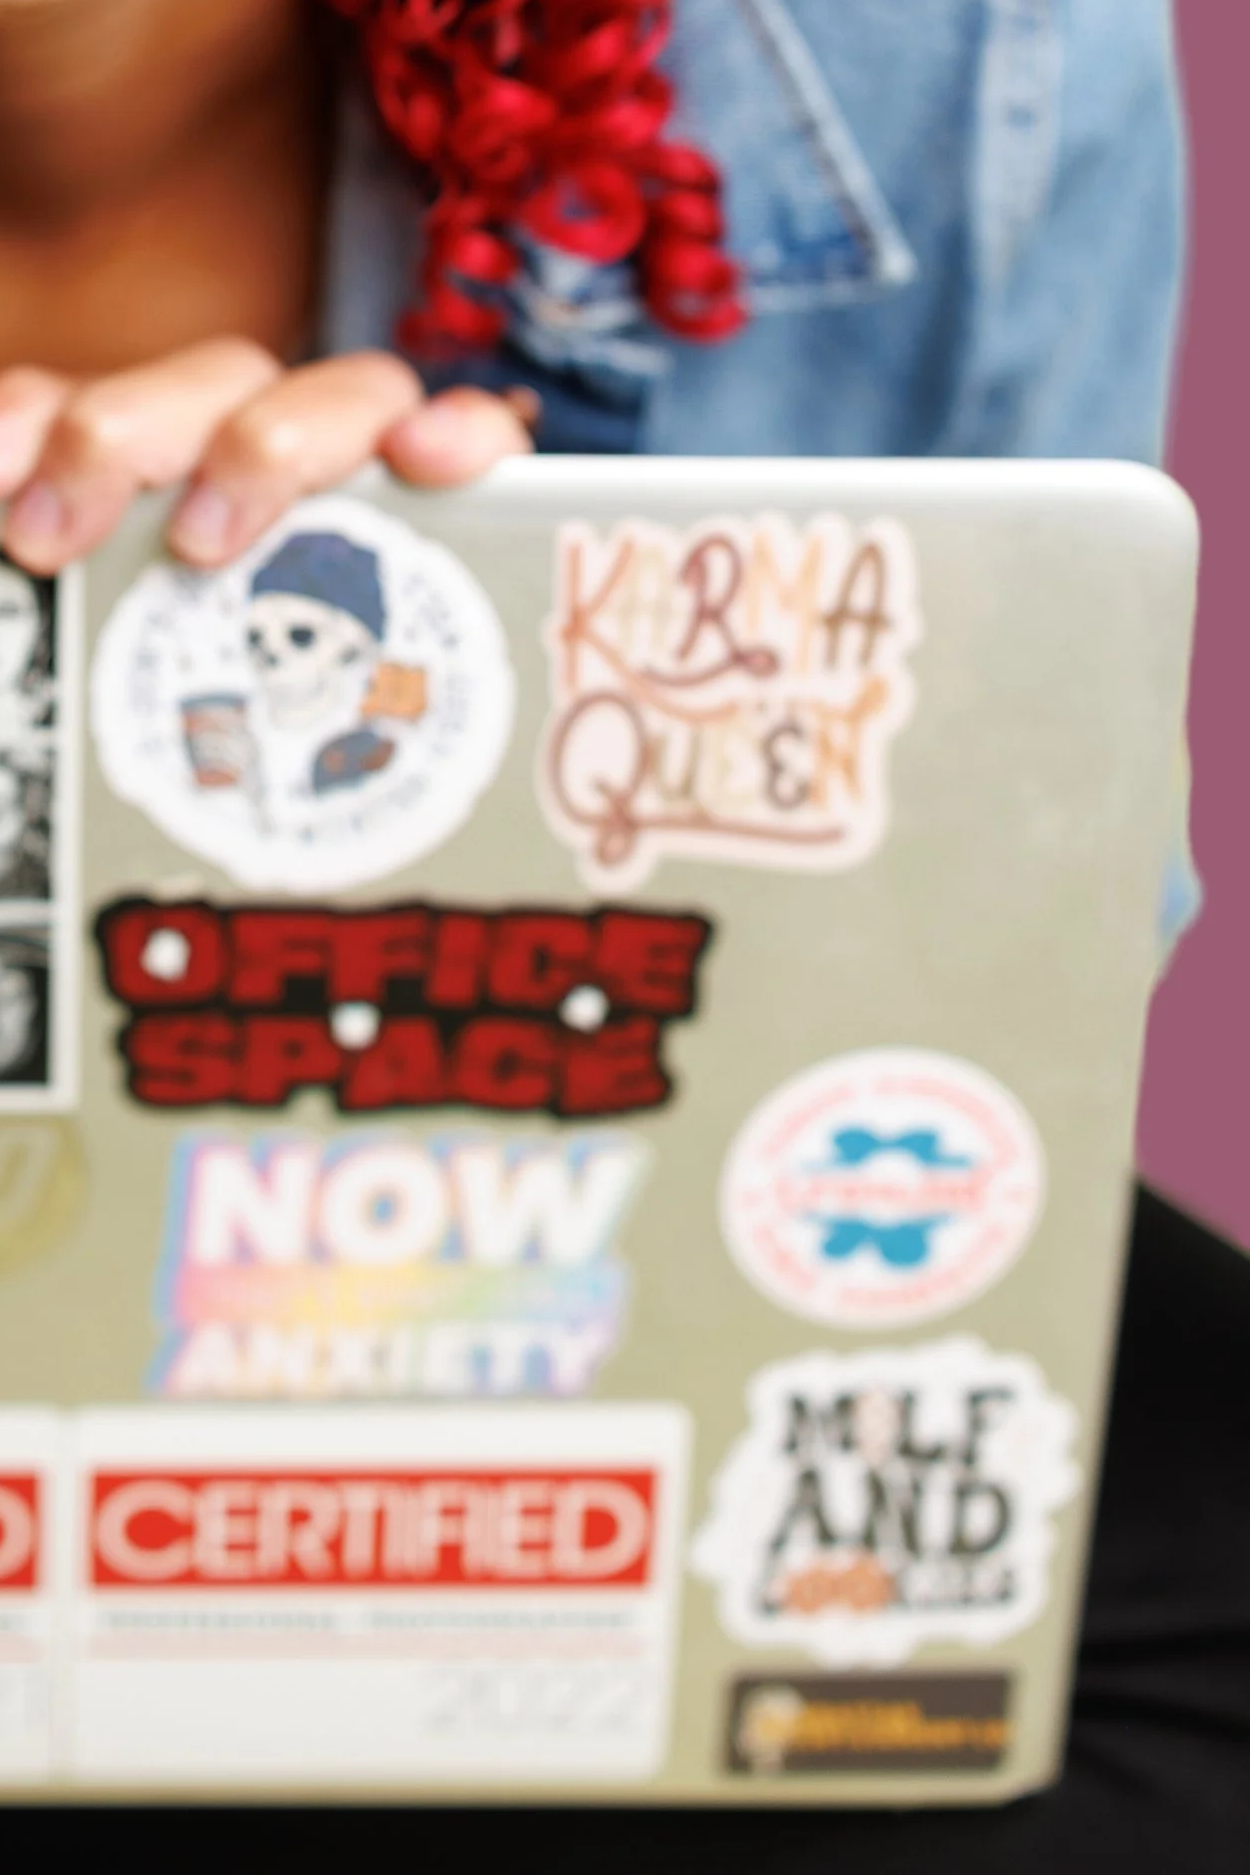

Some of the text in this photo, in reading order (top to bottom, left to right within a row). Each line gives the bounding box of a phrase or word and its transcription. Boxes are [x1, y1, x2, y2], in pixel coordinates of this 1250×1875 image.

[559, 529, 893, 723] KARMA
[548, 678, 889, 866] QUEEN
[100, 904, 712, 1012] OFFICE
[124, 1013, 672, 1115] SPACE
[186, 1139, 642, 1266] NOW
[162, 1321, 608, 1397] ANXIETY
[95, 1477, 651, 1582] CERTIFIED
[768, 1467, 1014, 1561] AND
